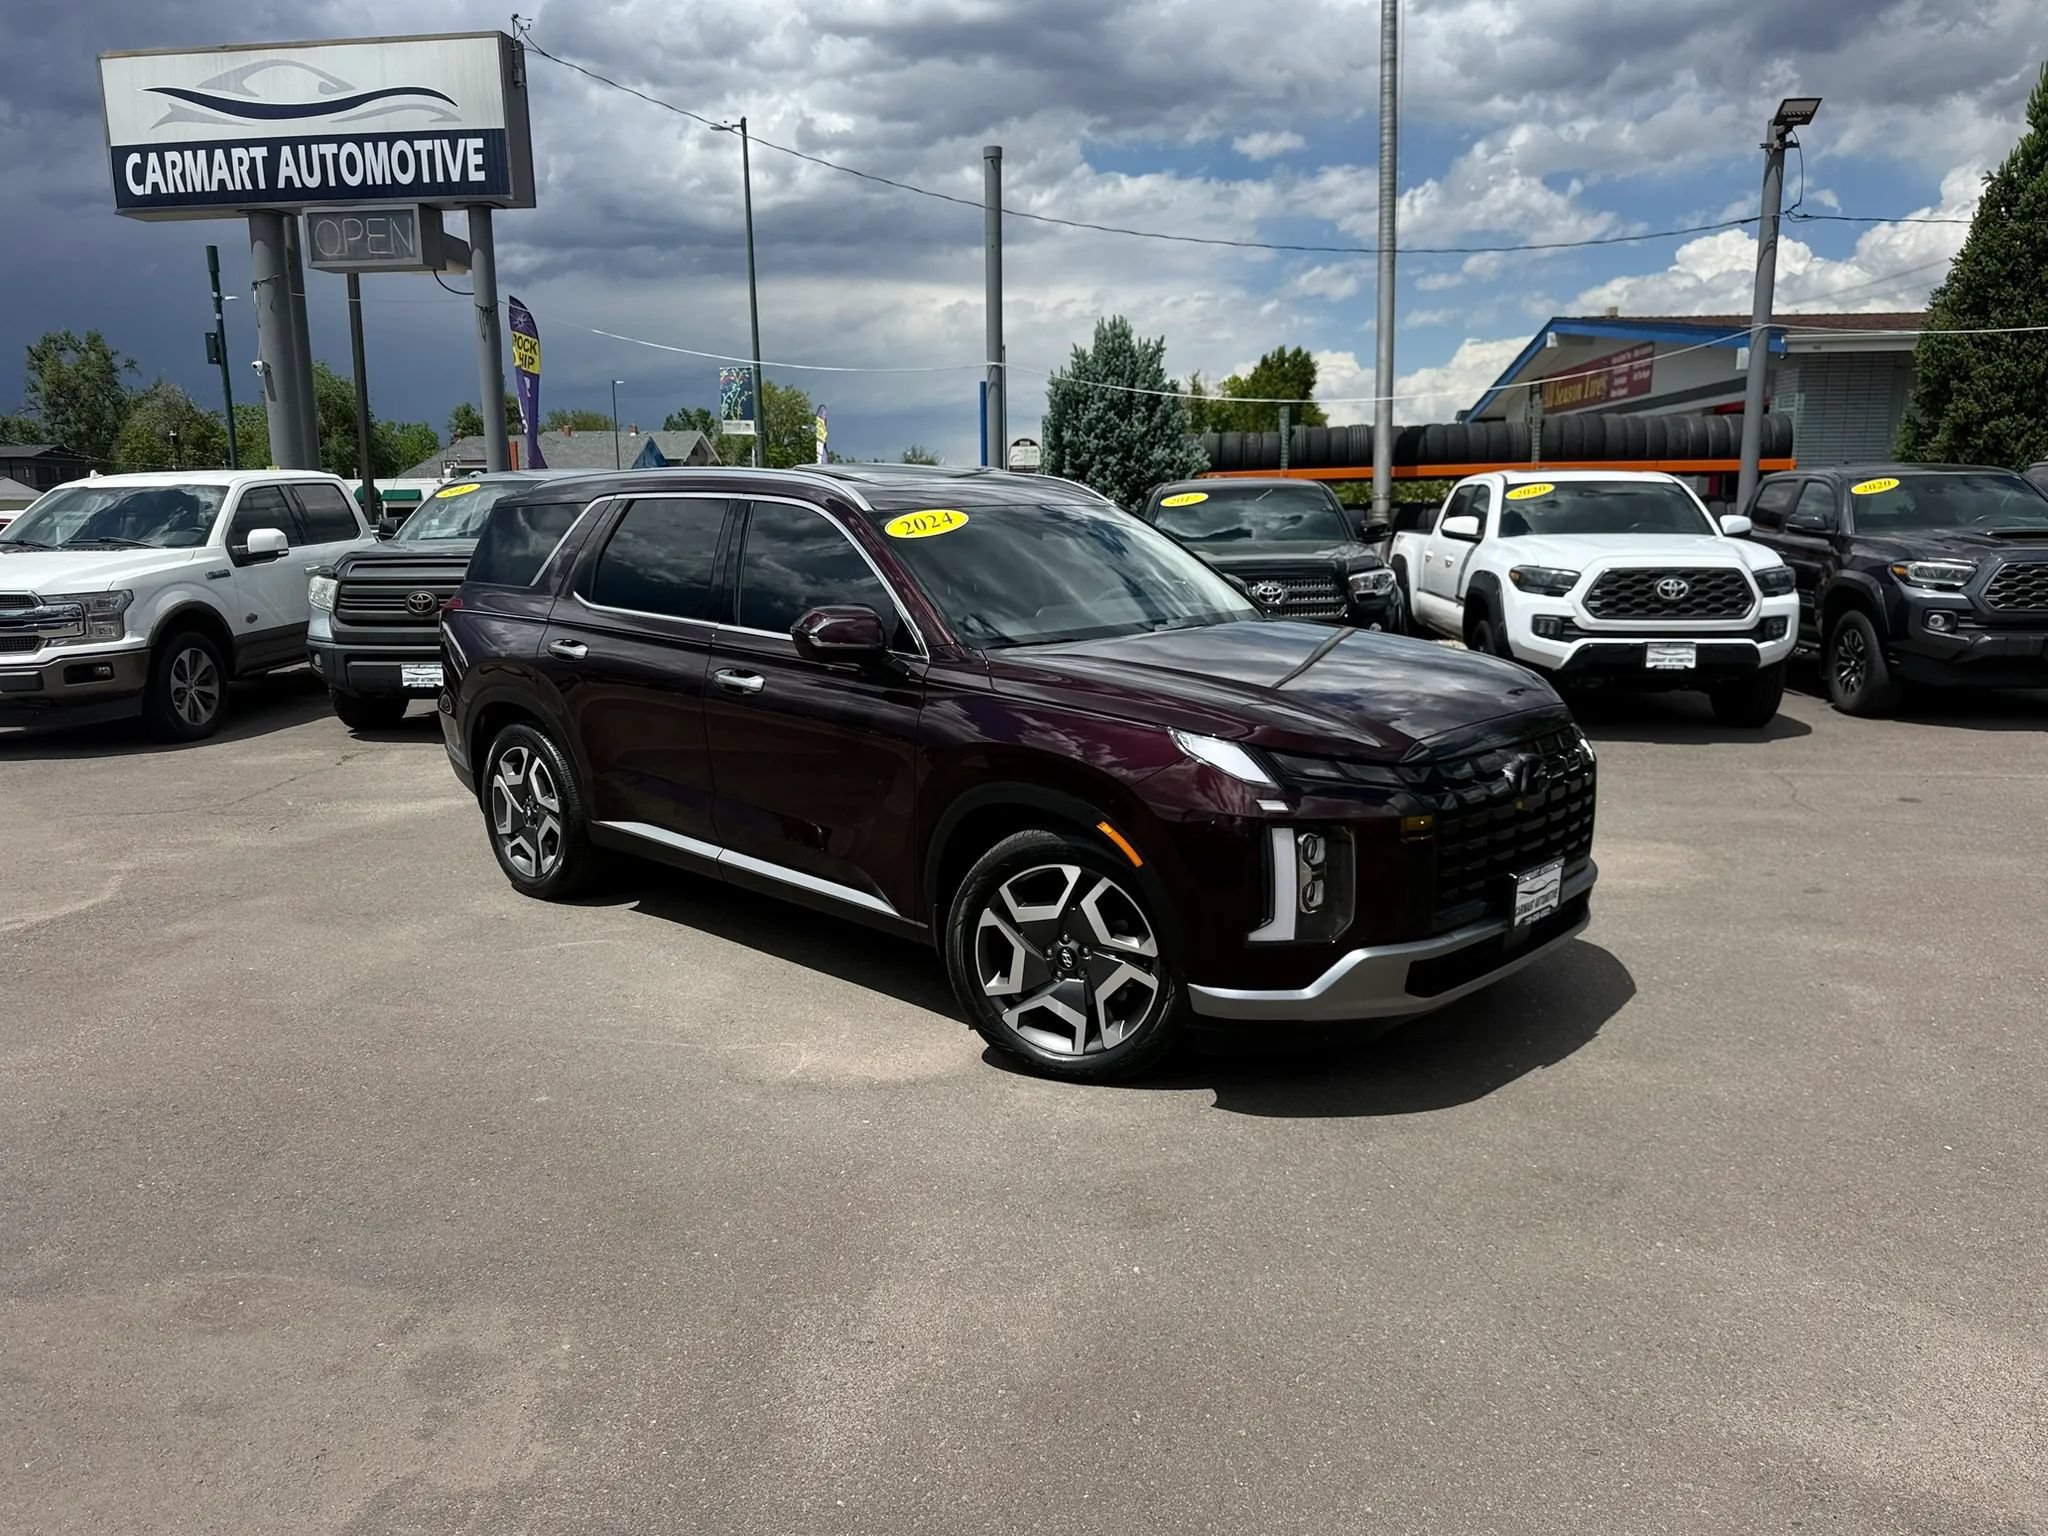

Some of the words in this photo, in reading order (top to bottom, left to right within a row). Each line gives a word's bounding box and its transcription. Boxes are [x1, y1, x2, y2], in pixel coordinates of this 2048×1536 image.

[125, 146, 268, 196] CARMART
[277, 138, 486, 189] AUTOMOTIVE
[314, 216, 414, 256] OPEN
[900, 512, 953, 535] 2024
